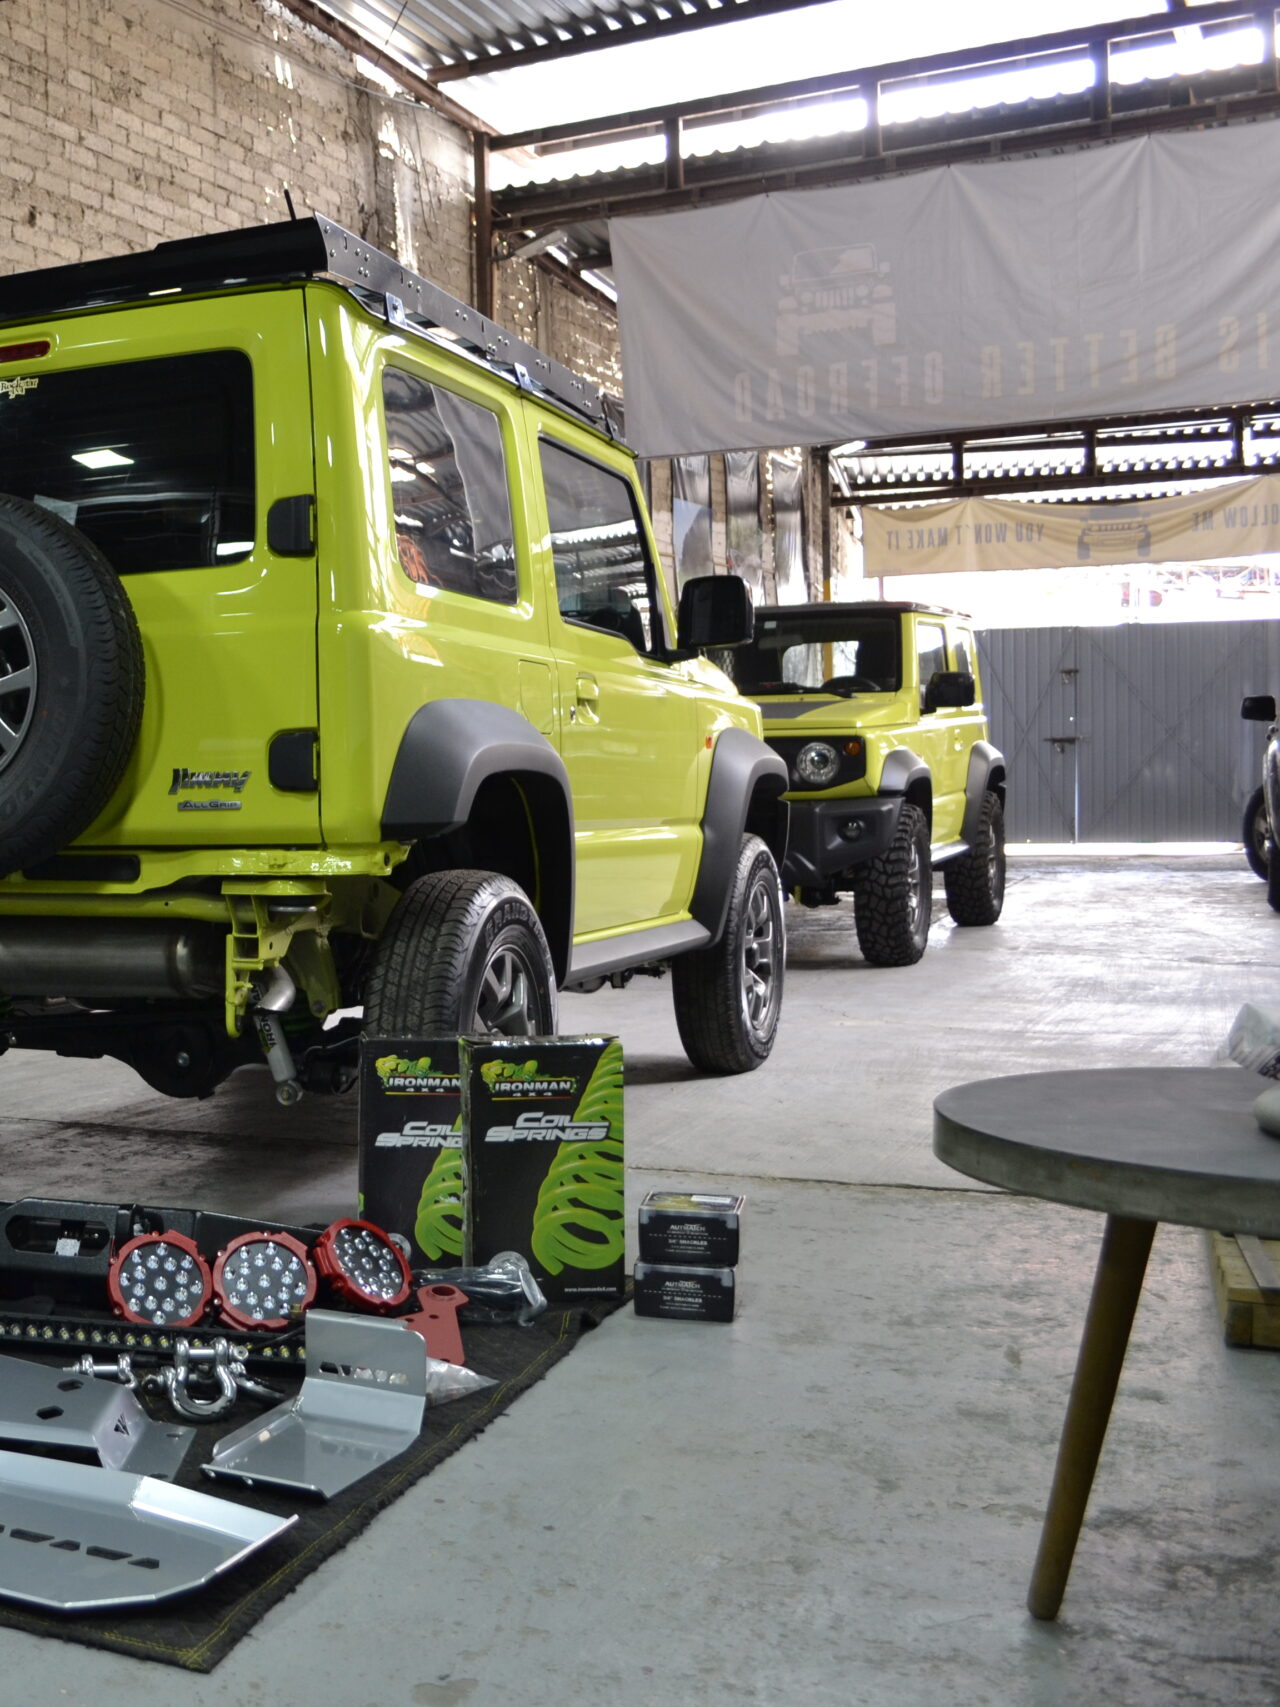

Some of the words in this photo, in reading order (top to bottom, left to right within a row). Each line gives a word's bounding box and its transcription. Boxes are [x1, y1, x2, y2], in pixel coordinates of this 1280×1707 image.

[389, 1078, 461, 1087] IRONMAN
[495, 1081, 571, 1091] IRONMAN
[515, 1112, 610, 1128] COIL
[375, 1132, 463, 1147] SPRING
[484, 1126, 608, 1142] SPRINGS
